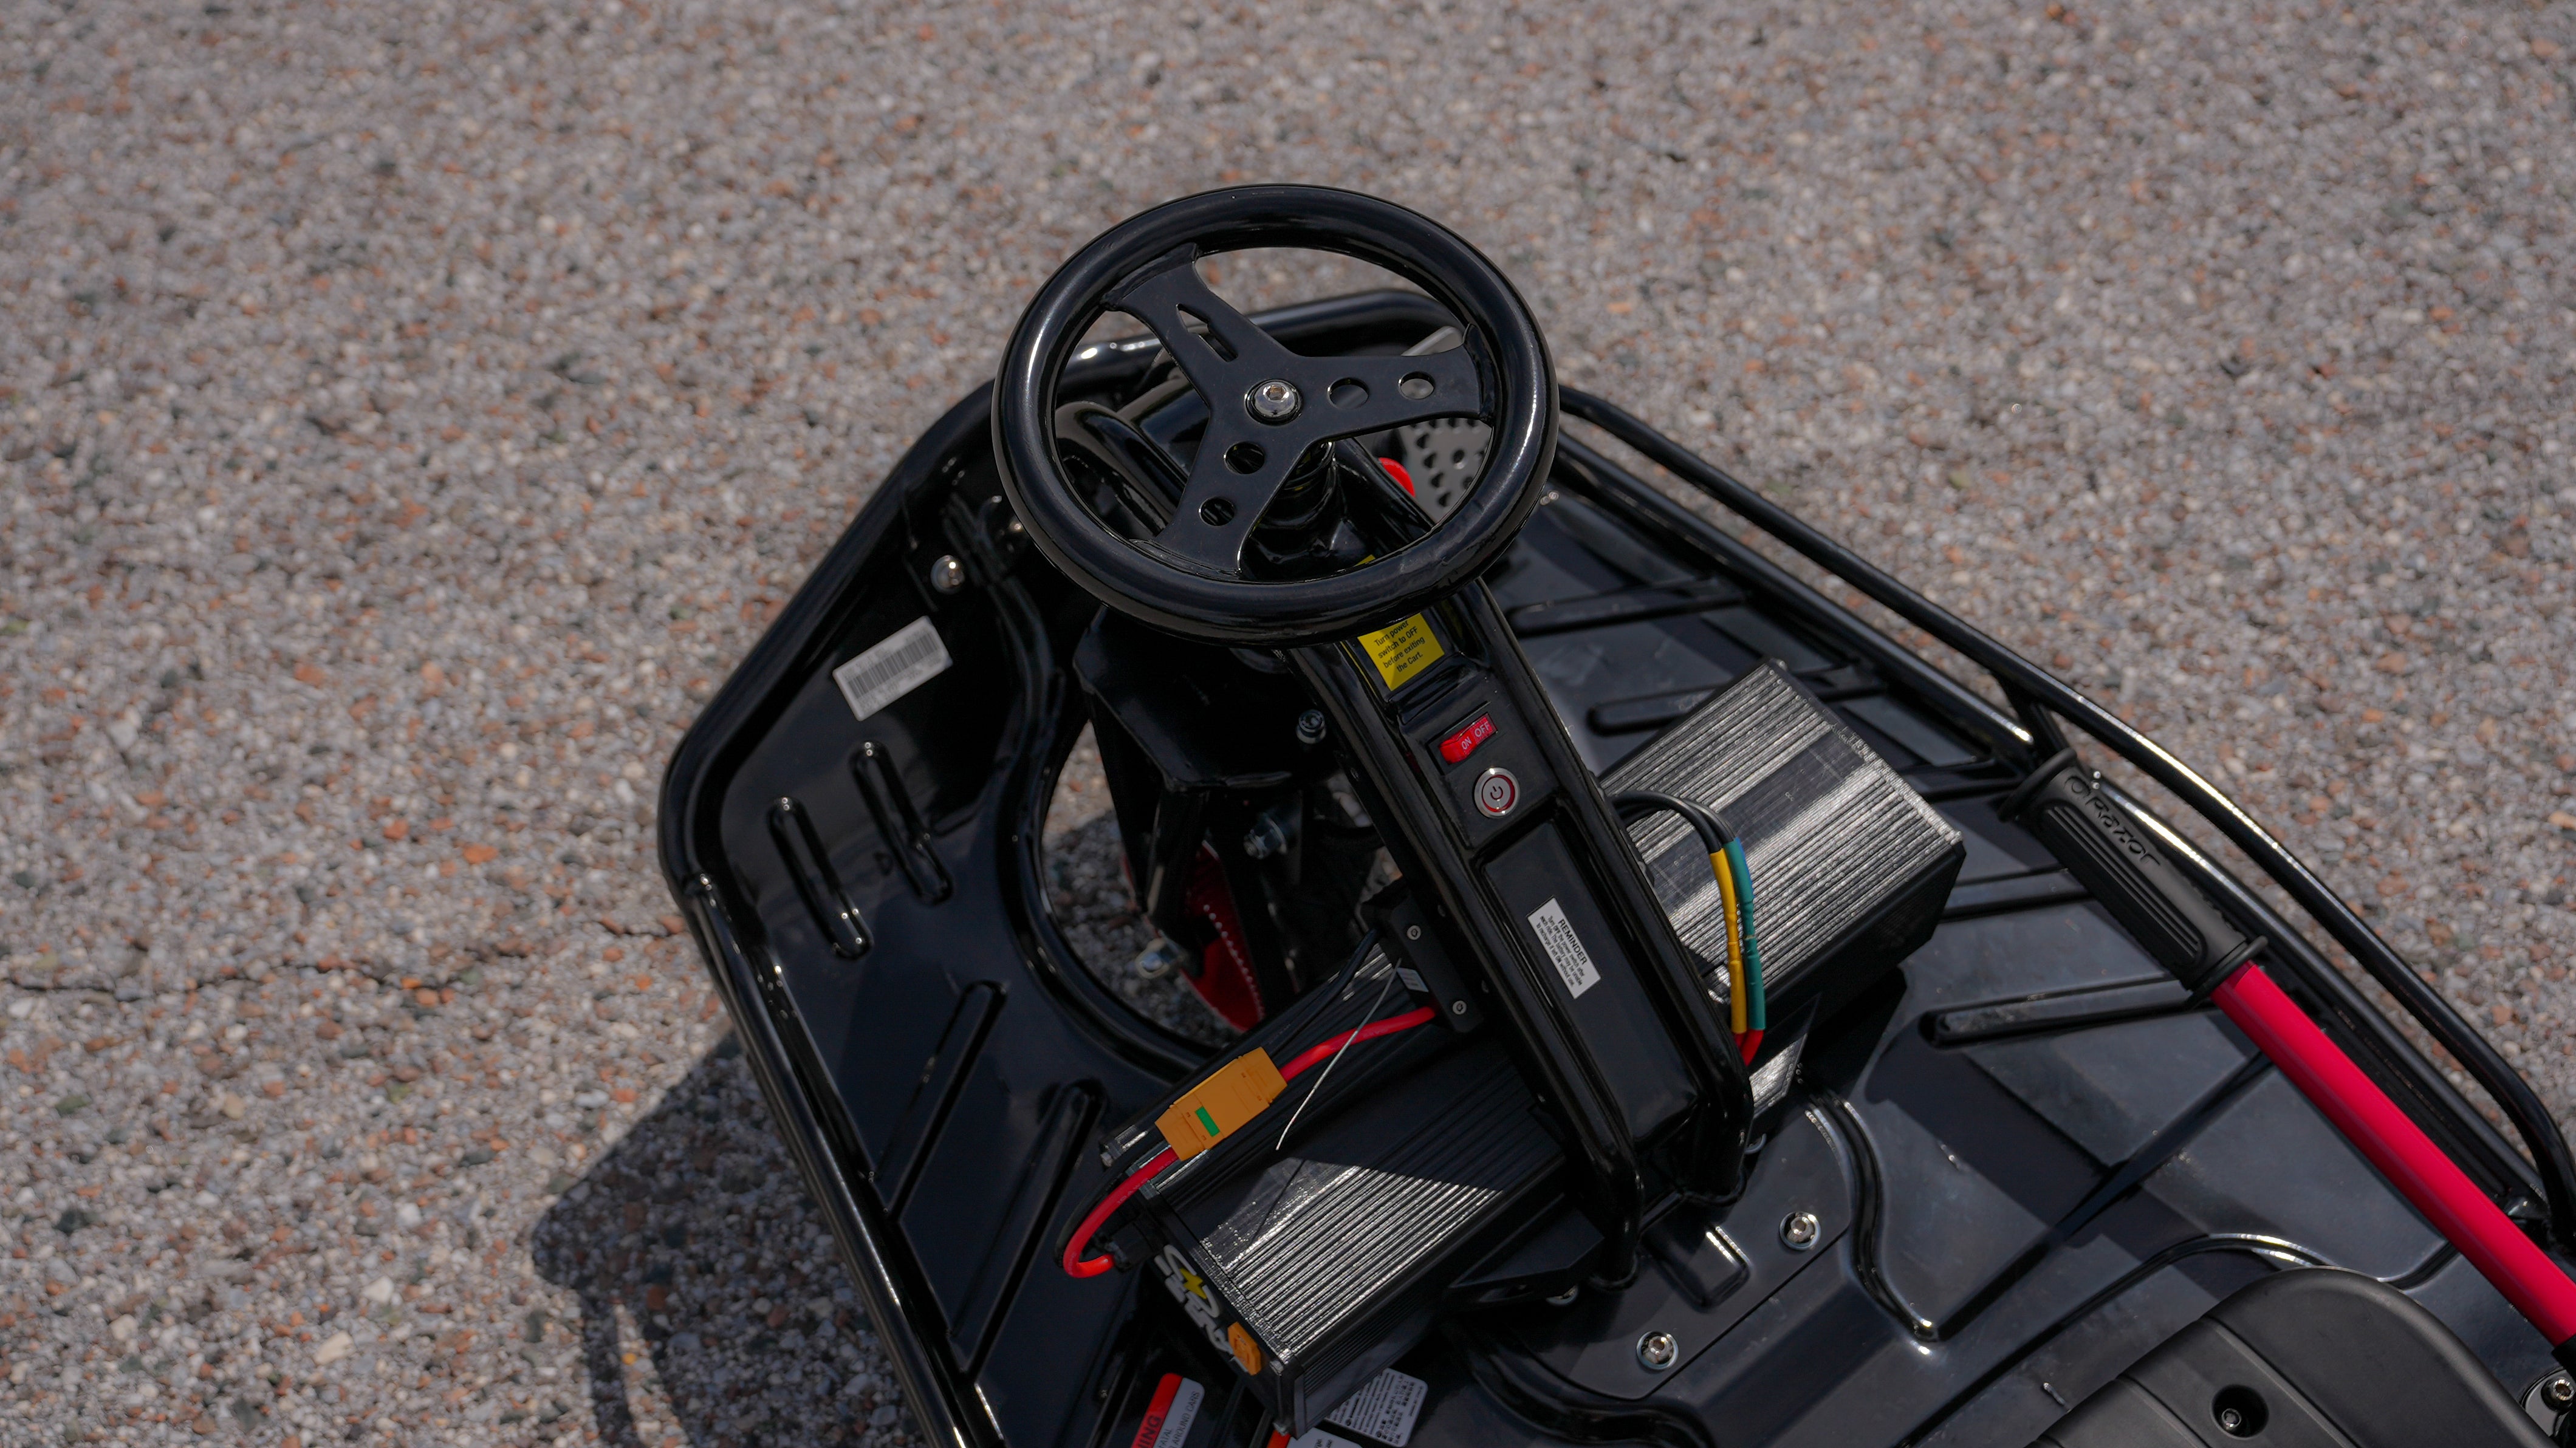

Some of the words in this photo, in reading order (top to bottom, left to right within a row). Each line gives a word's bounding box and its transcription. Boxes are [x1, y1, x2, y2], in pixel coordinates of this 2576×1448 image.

[1374, 634, 1389, 646] Turn
[1389, 620, 1409, 638] power
[1378, 641, 1399, 658] switch
[1405, 626, 1417, 638] OFF
[1383, 652, 1404, 668] before
[1404, 637, 1425, 654] exiting
[1397, 662, 1408, 672] the
[1408, 652, 1423, 664] Cart.
[1461, 736, 1472, 750] ON
[1474, 722, 1490, 737] OFF
[1538, 927, 1552, 946] recharge
[1560, 963, 1571, 977] without
[1555, 943, 1566, 957] battery
[1558, 918, 1587, 964] REMINDER
[1561, 941, 1571, 954] power
[1569, 954, 1579, 967] switch
[1172, 1413, 1191, 1445] AROUND
[1186, 1391, 1200, 1412] CARS
